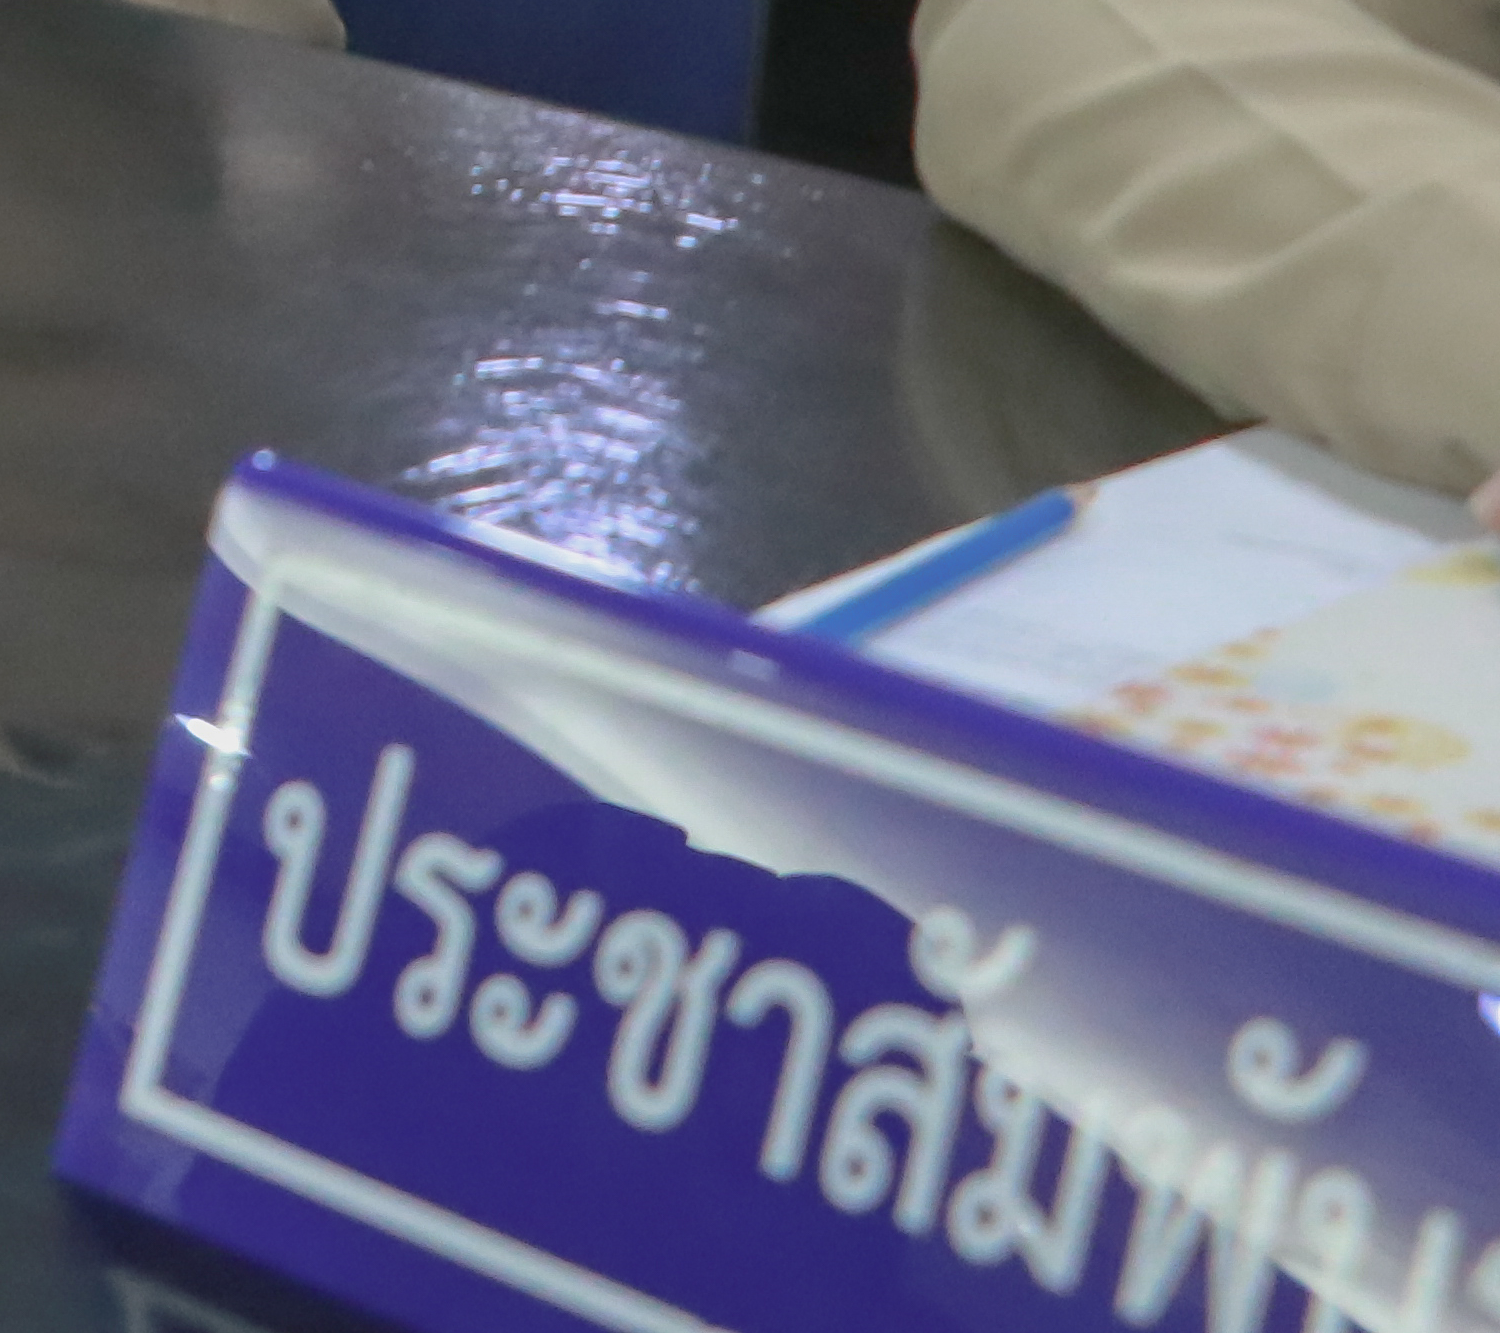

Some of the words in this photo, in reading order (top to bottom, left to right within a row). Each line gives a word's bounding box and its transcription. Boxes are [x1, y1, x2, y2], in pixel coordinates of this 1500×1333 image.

[261, 742, 1500, 1333] ประชาสัมพัน
